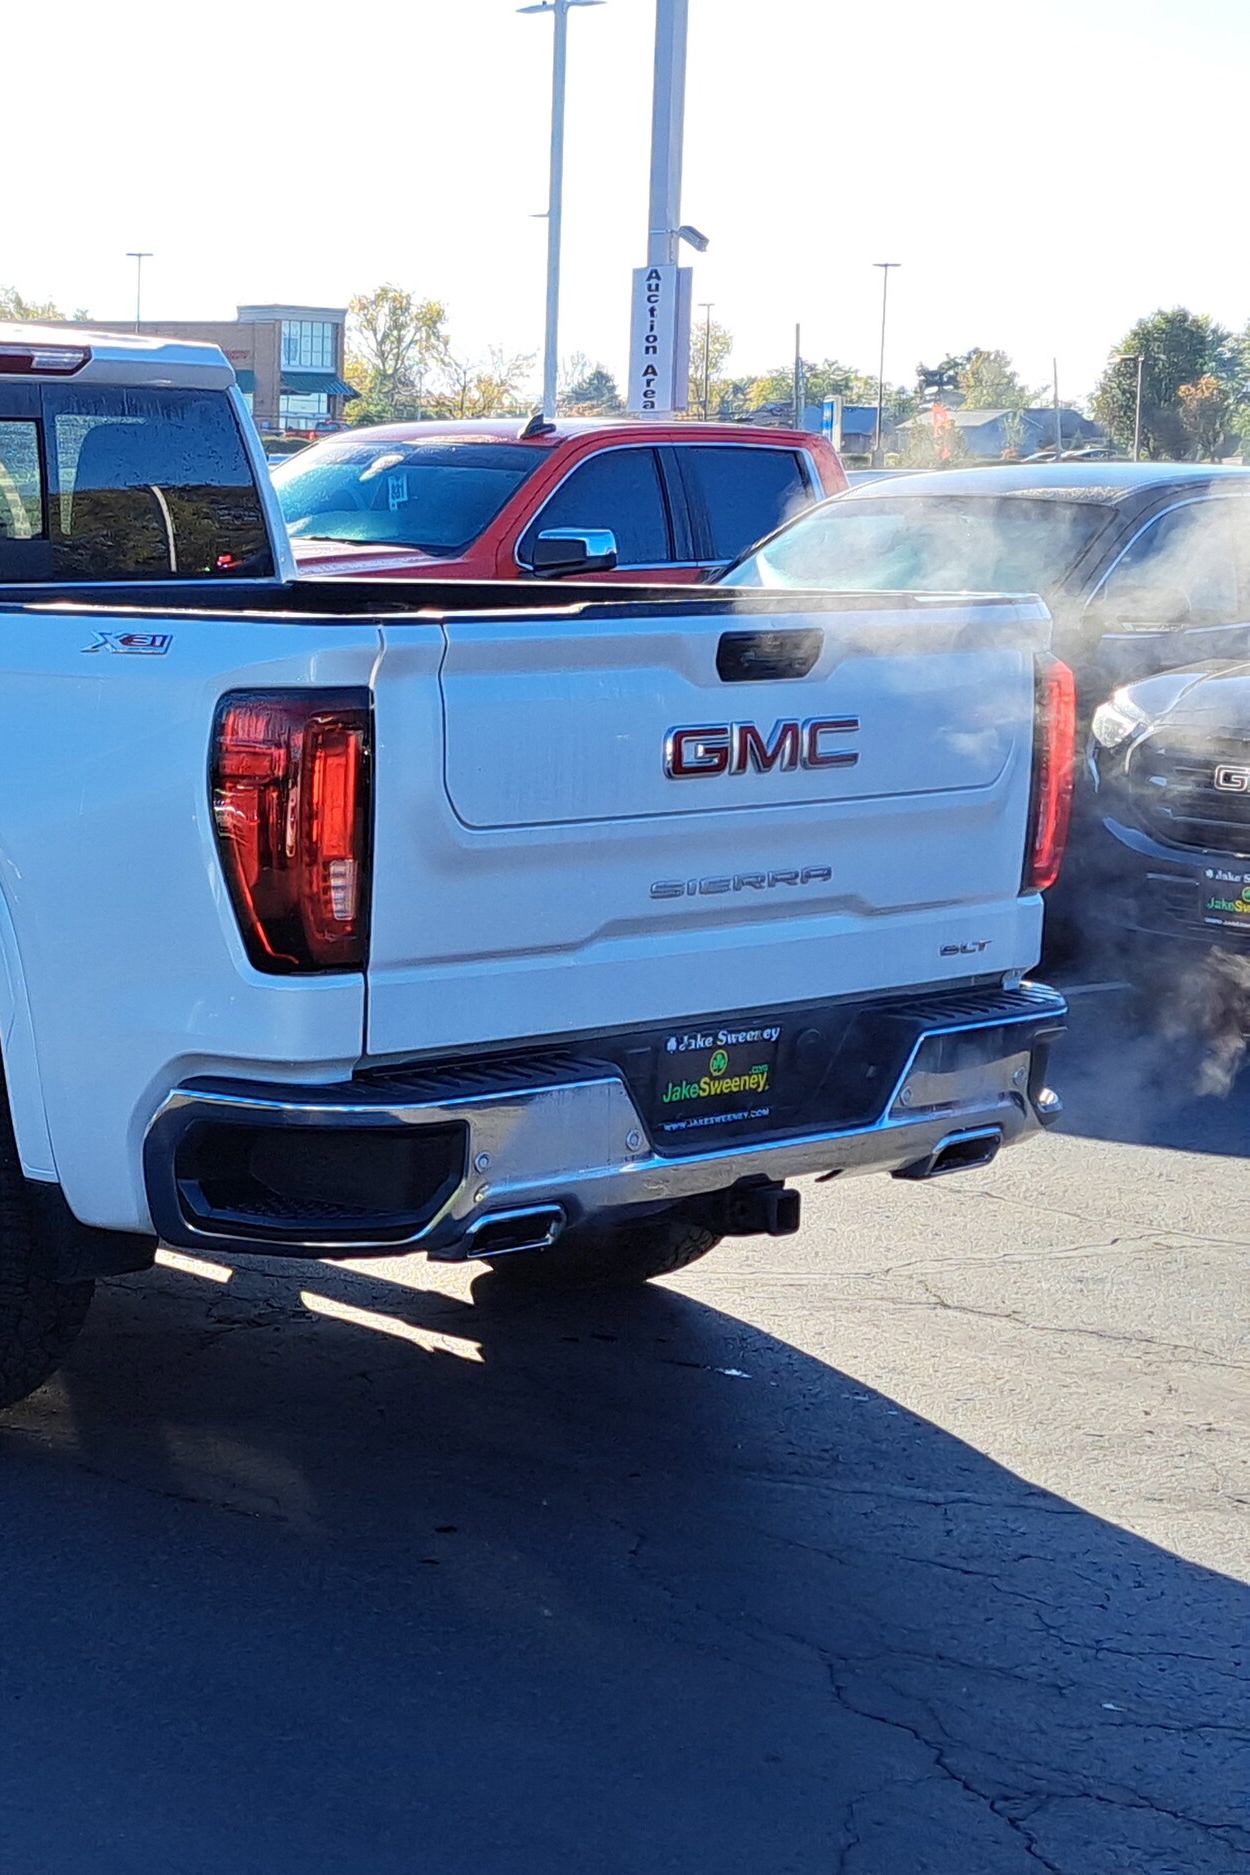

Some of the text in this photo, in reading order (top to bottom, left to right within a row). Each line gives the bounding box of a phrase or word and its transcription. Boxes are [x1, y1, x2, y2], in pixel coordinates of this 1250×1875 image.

[642, 268, 662, 410] Auction Area
[662, 714, 860, 780] GMC
[649, 864, 832, 900] SIERRA
[939, 939, 992, 956] SLT
[678, 1027, 781, 1051] Jake Sweeney
